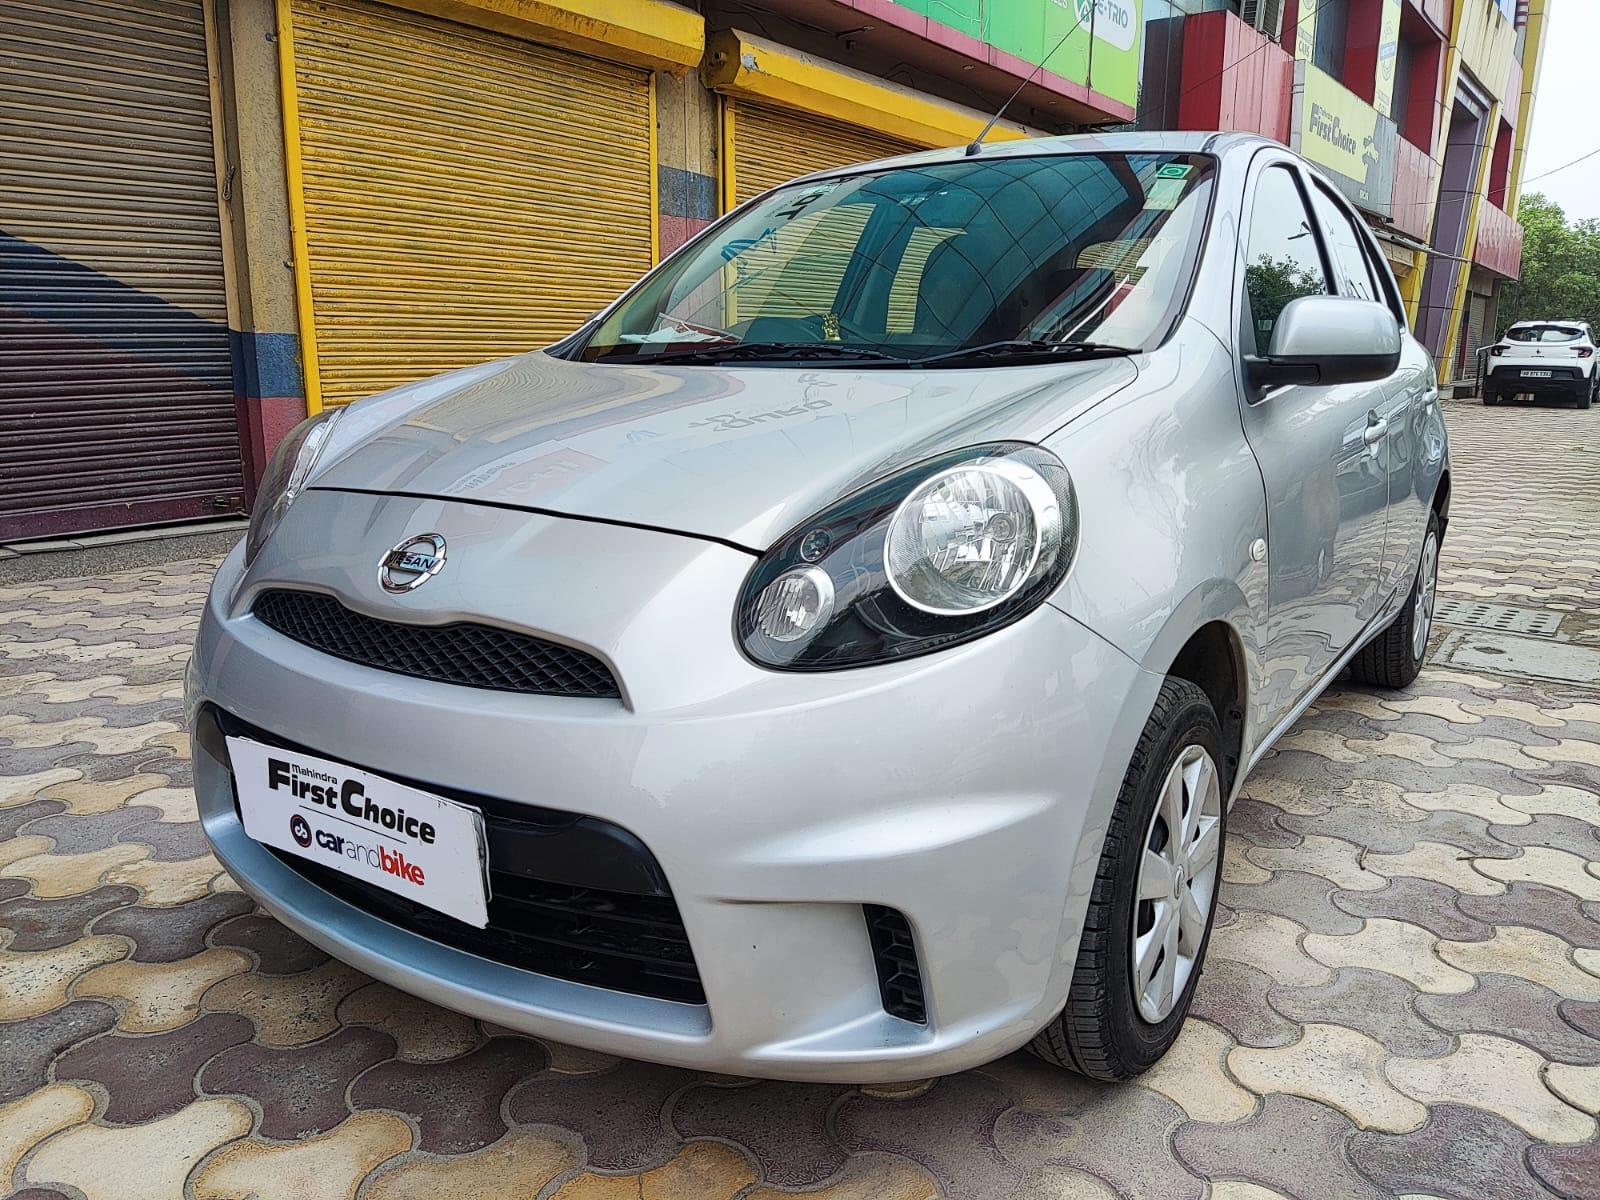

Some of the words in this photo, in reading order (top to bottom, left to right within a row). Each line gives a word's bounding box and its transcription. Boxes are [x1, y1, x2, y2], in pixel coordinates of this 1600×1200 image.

[1309, 102, 1332, 142] First
[1331, 116, 1357, 155] Choice
[291, 763, 338, 785] mahindra
[268, 757, 338, 810] First
[341, 779, 436, 845] Choice
